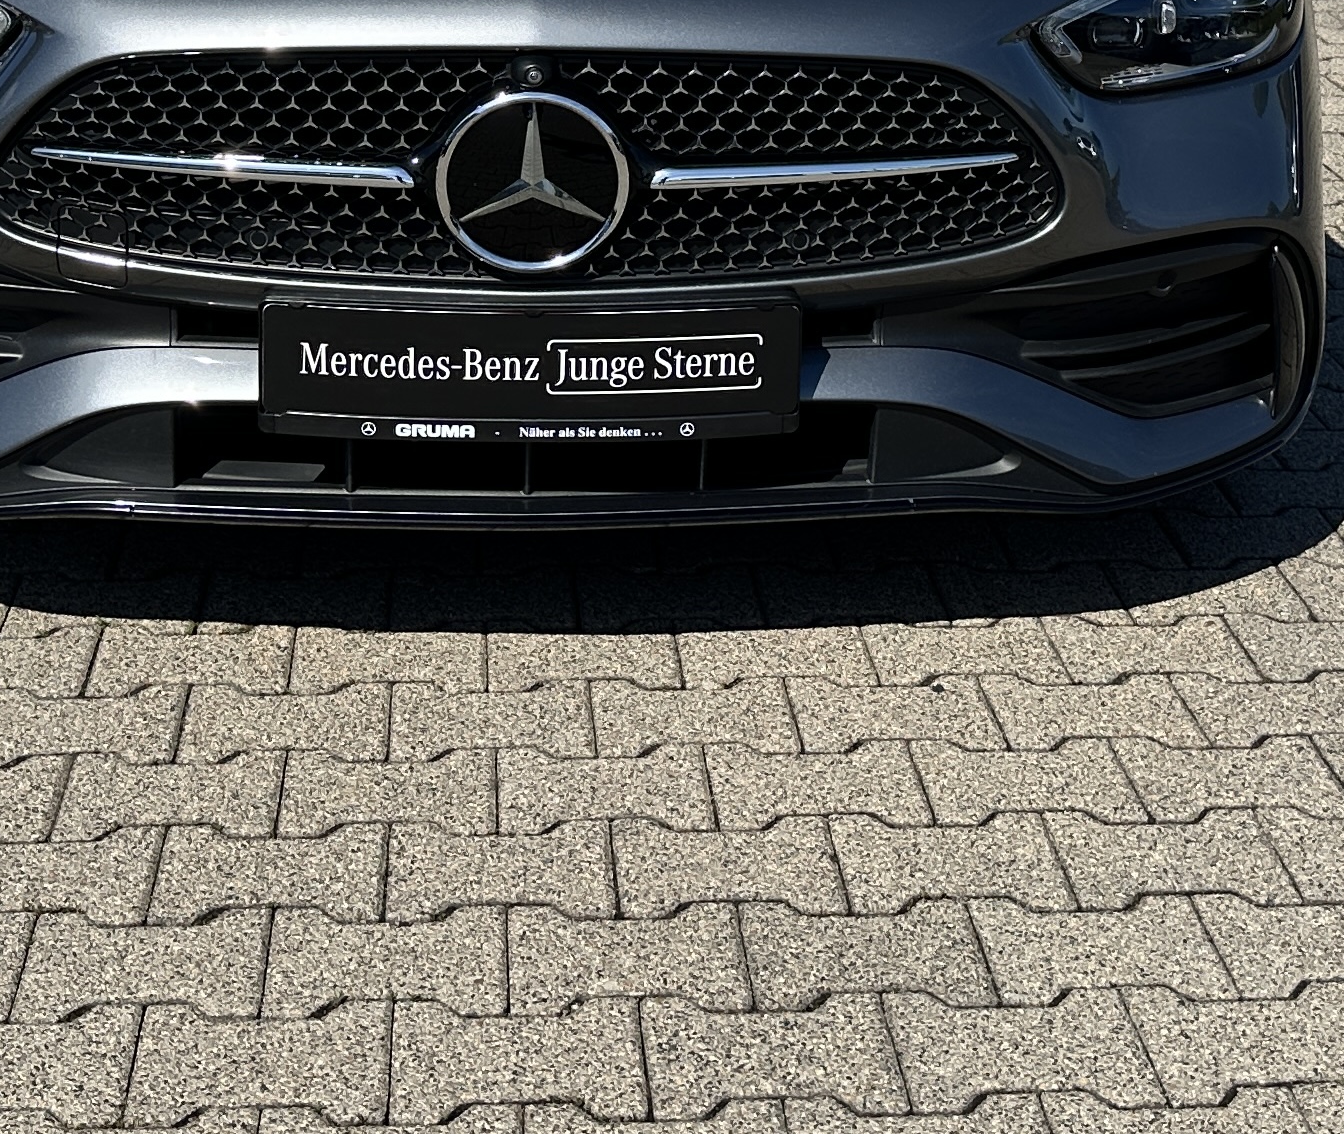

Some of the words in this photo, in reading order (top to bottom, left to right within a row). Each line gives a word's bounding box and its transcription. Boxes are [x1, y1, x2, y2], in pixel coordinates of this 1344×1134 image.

[299, 341, 540, 381] Mercedes-Benz
[554, 348, 645, 388] Junge
[653, 346, 755, 380] Sterne
[395, 423, 476, 439] GRUMA
[519, 426, 556, 438] Näher
[558, 427, 575, 438] als
[577, 427, 596, 438] Sie
[598, 427, 642, 438] denken
